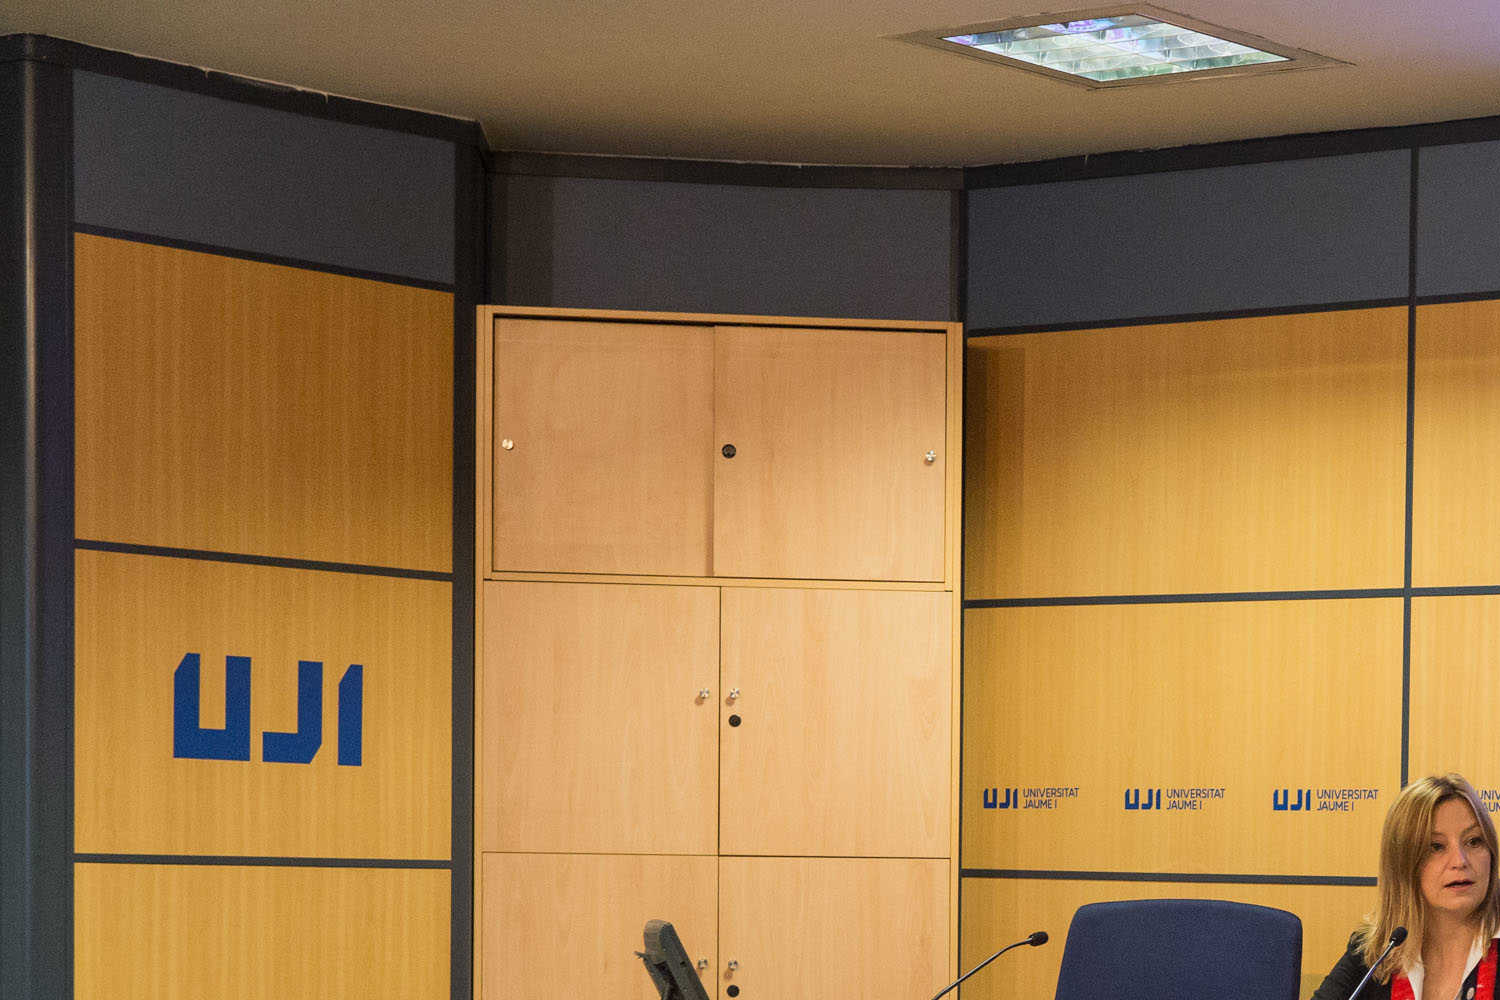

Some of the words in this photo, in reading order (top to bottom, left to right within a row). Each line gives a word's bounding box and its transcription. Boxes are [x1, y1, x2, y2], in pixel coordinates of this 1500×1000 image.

[173, 652, 363, 767] UJI
[1023, 787, 1079, 798] UNIVERSITAT
[1166, 788, 1225, 799] UNIVERSITAT
[1316, 789, 1379, 800] UNIVERSITAT
[983, 788, 1019, 809] UJI
[1023, 799, 1053, 809] JAUME
[1124, 789, 1161, 810] UJI
[1272, 789, 1310, 811] UJI
[1166, 800, 1199, 811] JAUME
[1316, 801, 1349, 811] JAUME
